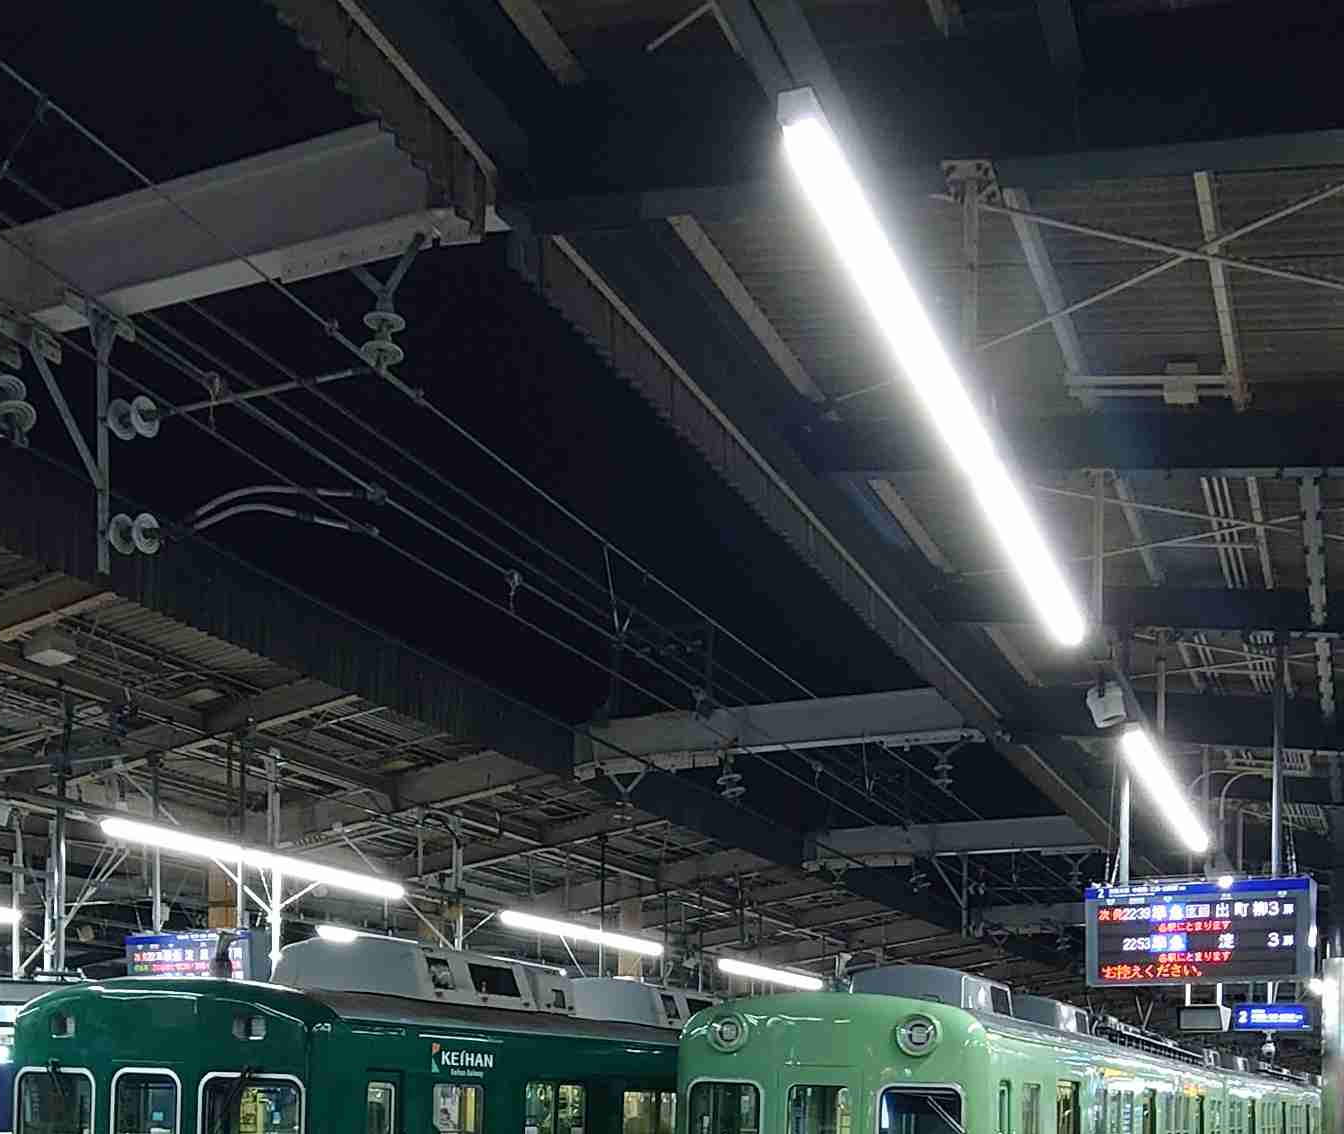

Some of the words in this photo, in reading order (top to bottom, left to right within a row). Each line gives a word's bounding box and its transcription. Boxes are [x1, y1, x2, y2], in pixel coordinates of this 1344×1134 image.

[1122, 937, 1152, 951] 2253
[1238, 1009, 1249, 1024] 2
[441, 1049, 494, 1068] KEIHAN
